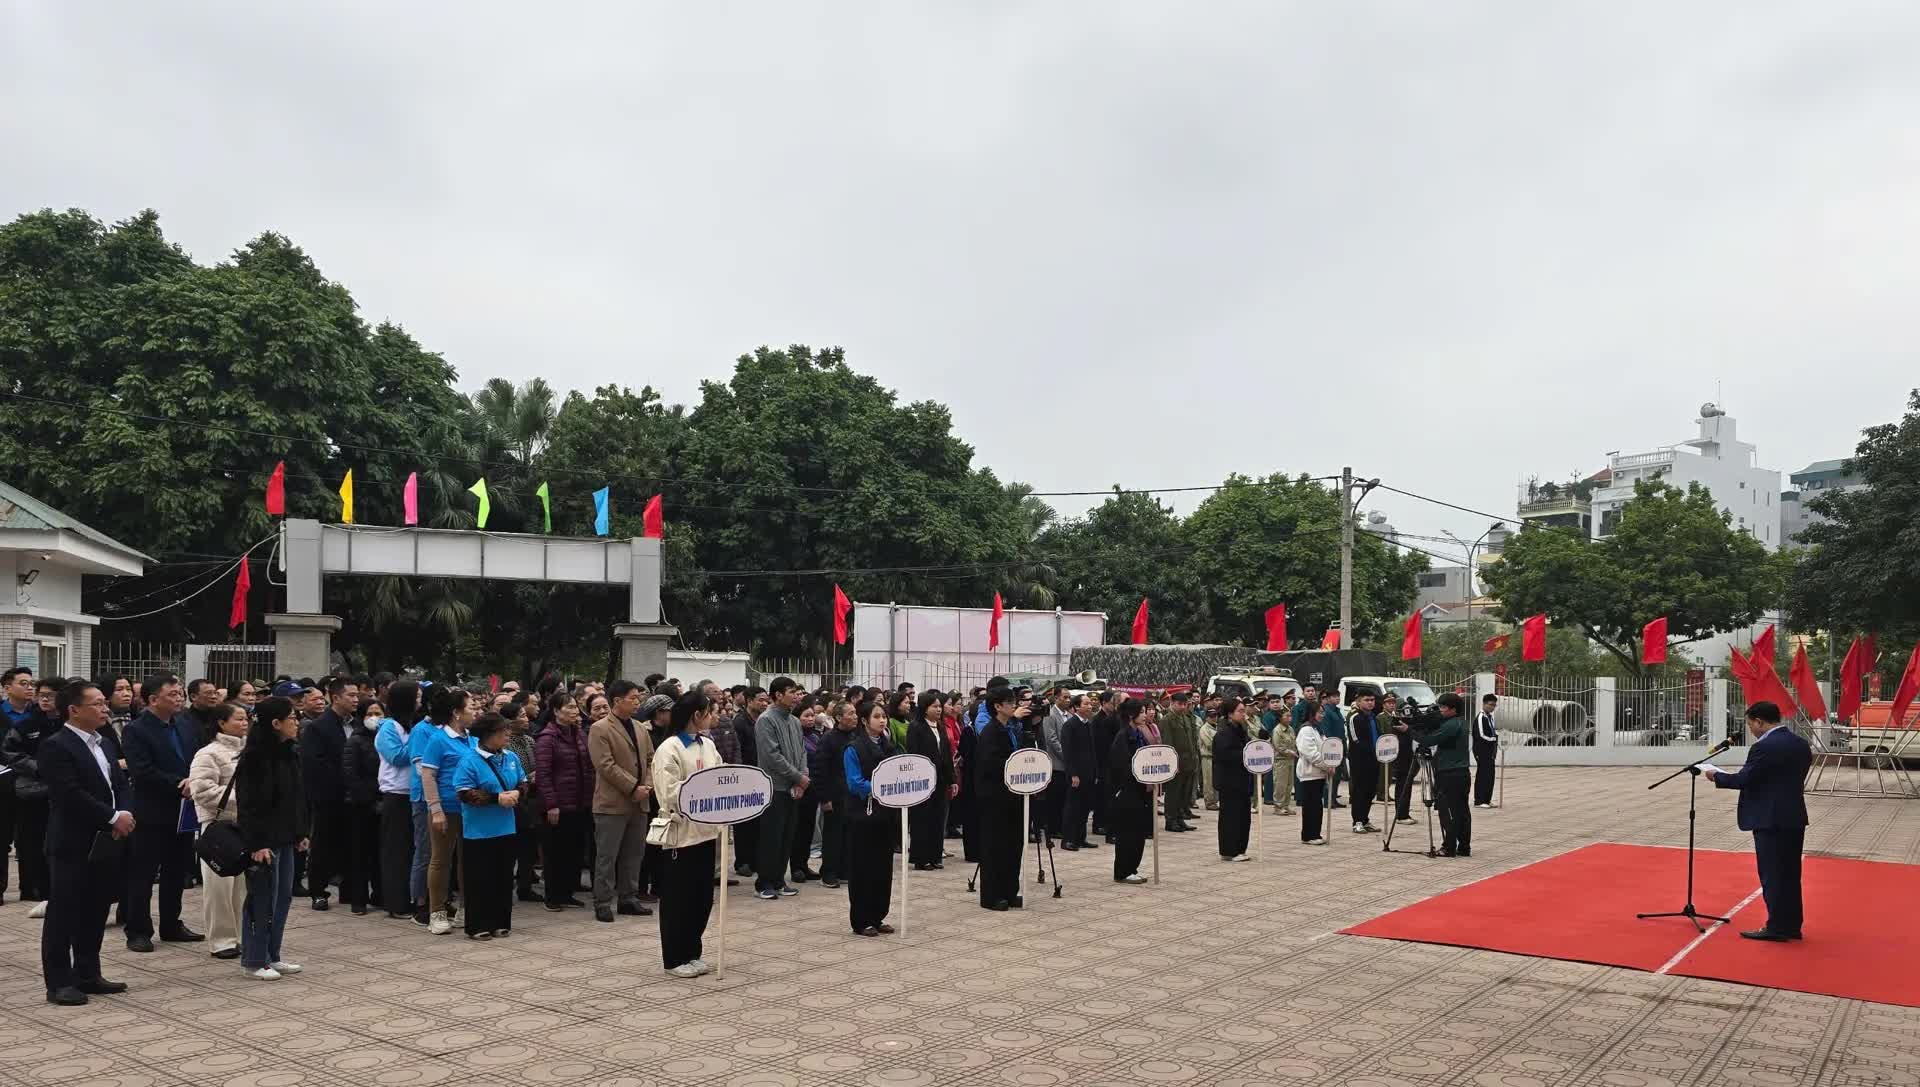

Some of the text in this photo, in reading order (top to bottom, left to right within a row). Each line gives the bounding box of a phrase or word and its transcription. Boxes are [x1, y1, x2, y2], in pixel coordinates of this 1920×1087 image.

[718, 771, 739, 785] KHỐI
[689, 789, 765, 814] ỦY BAN MTTQVN PHƯỜNG
